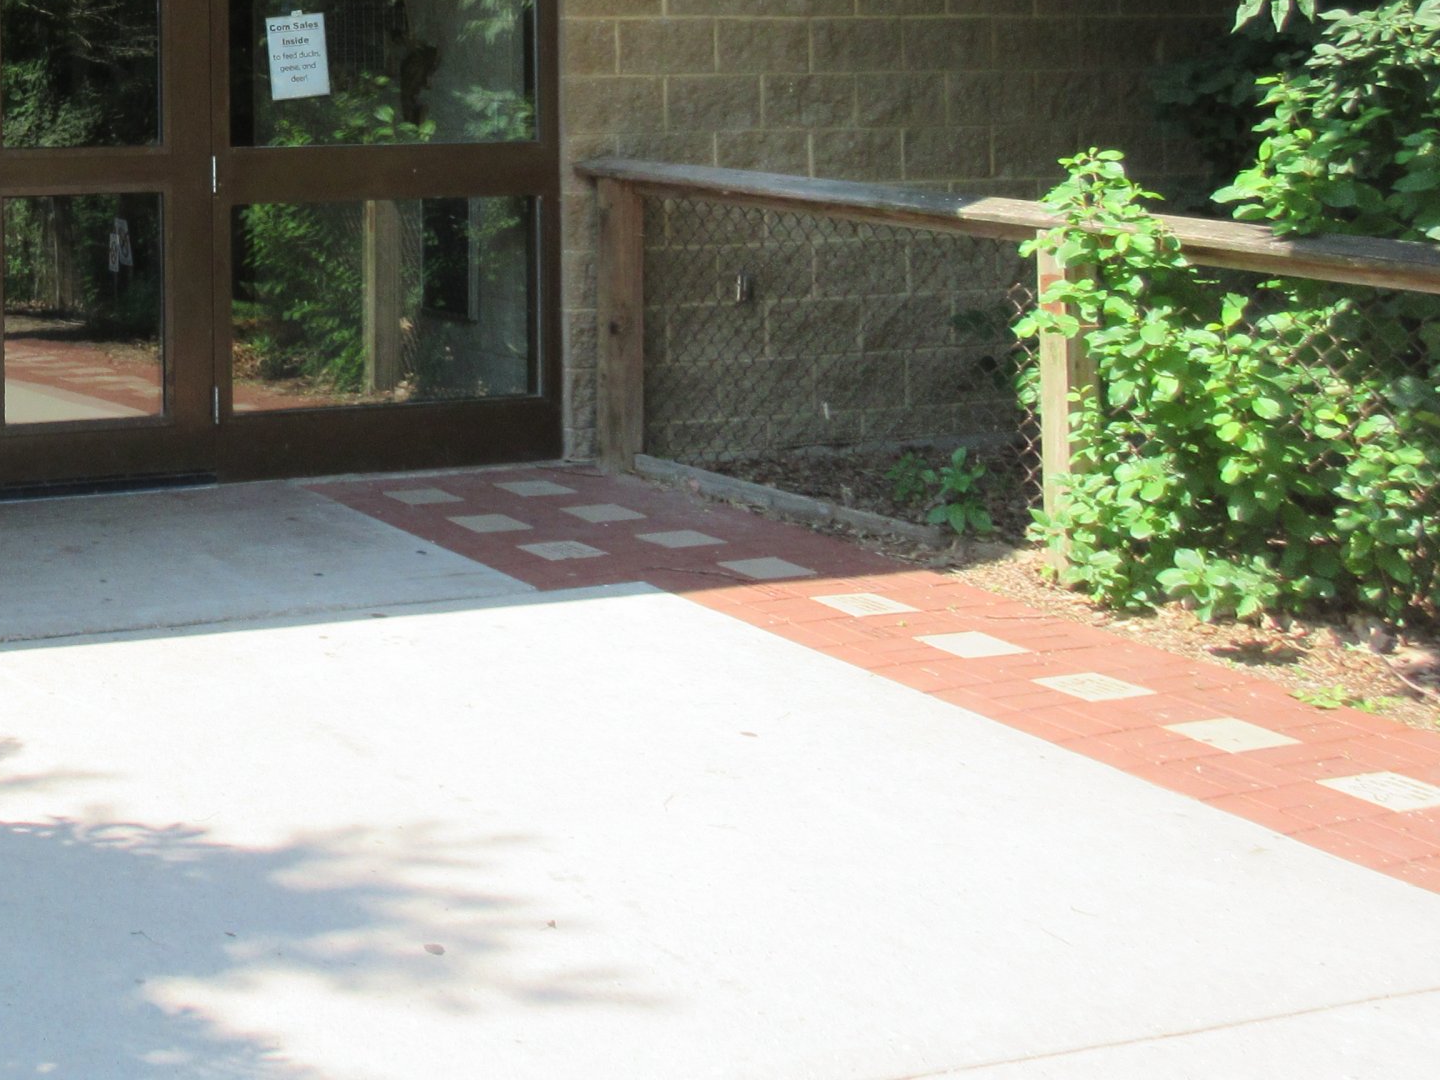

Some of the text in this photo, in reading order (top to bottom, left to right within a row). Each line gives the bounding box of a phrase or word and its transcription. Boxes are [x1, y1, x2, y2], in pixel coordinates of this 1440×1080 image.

[292, 21, 319, 30] Sales
[282, 36, 310, 45] Inside
[282, 51, 298, 60] feed
[301, 62, 317, 70] and
